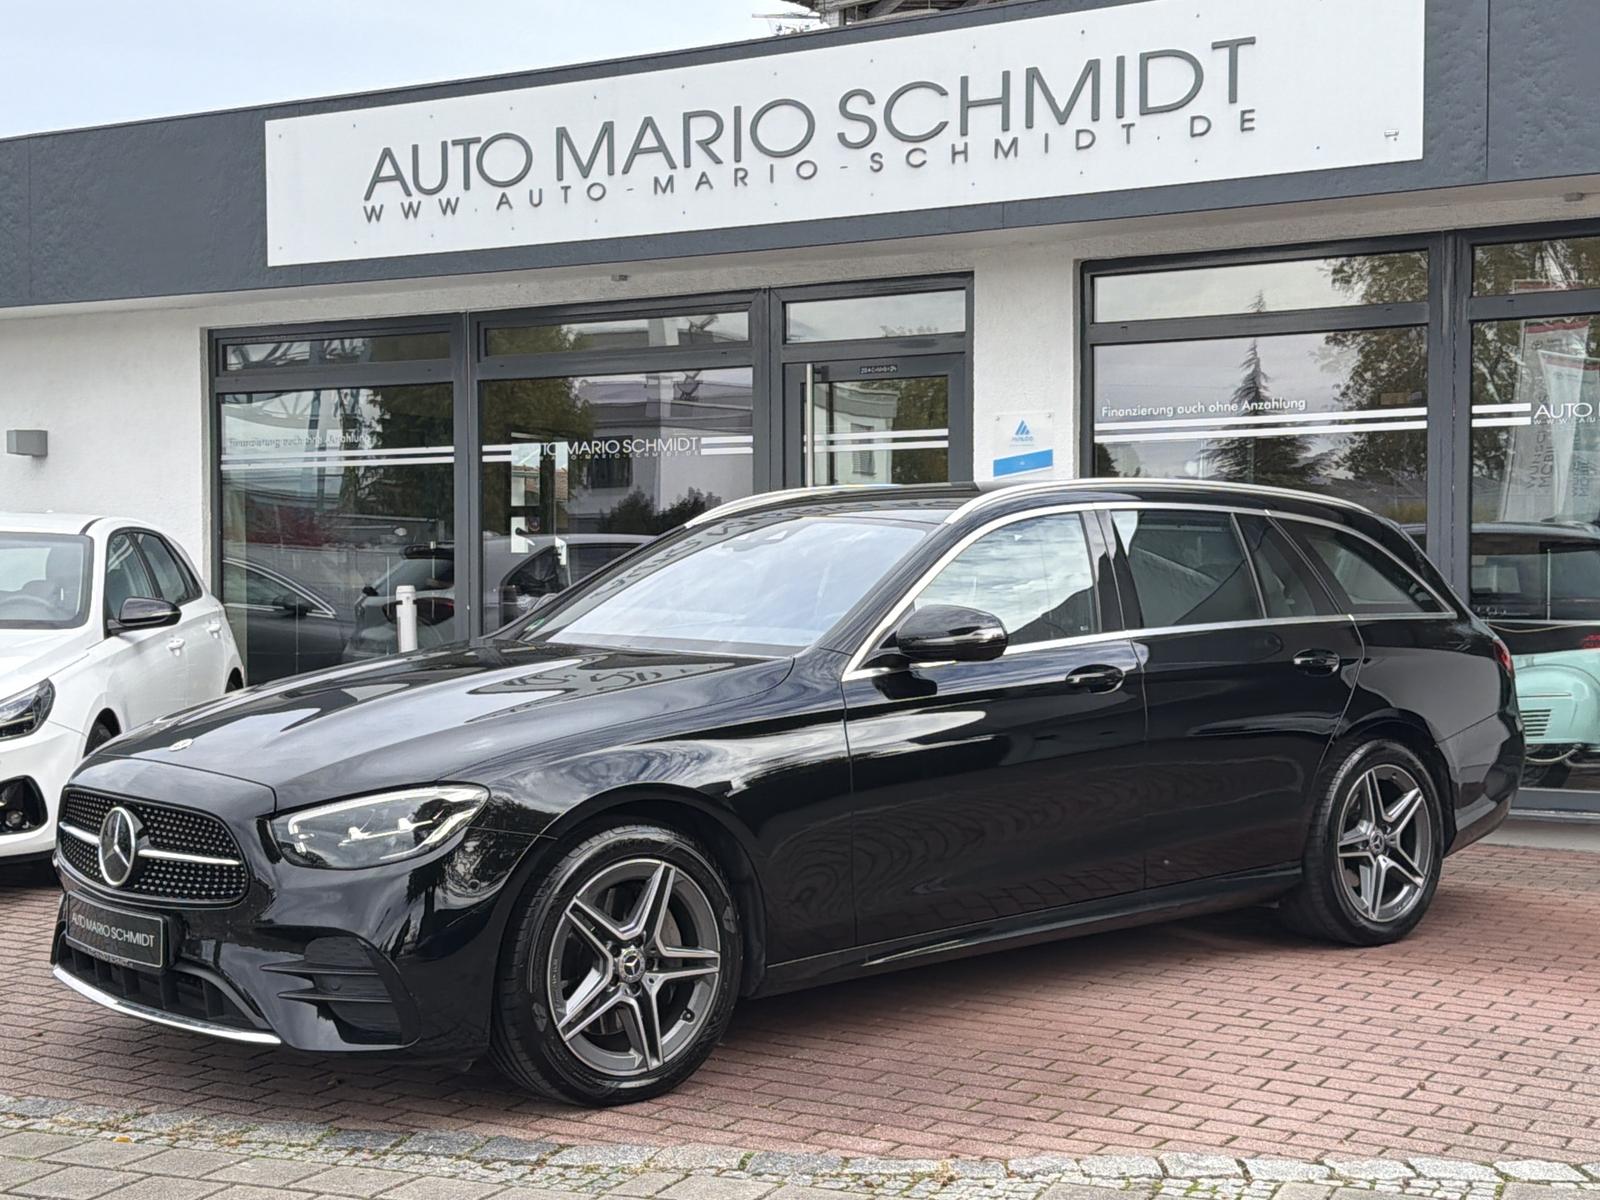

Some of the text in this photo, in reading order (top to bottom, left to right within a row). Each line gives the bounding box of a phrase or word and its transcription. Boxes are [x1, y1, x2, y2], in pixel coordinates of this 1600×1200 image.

[363, 36, 1257, 202] AUTO MARIO SCHMIDT
[1101, 397, 1307, 418] Finanzierung auch ohne Anzahlung
[1533, 402, 1593, 420] AUTO
[566, 439, 620, 455] MARIO
[622, 436, 699, 453] SCHMIDT
[86, 918, 110, 938] MARIO
[111, 925, 156, 948] SCHMIDT
